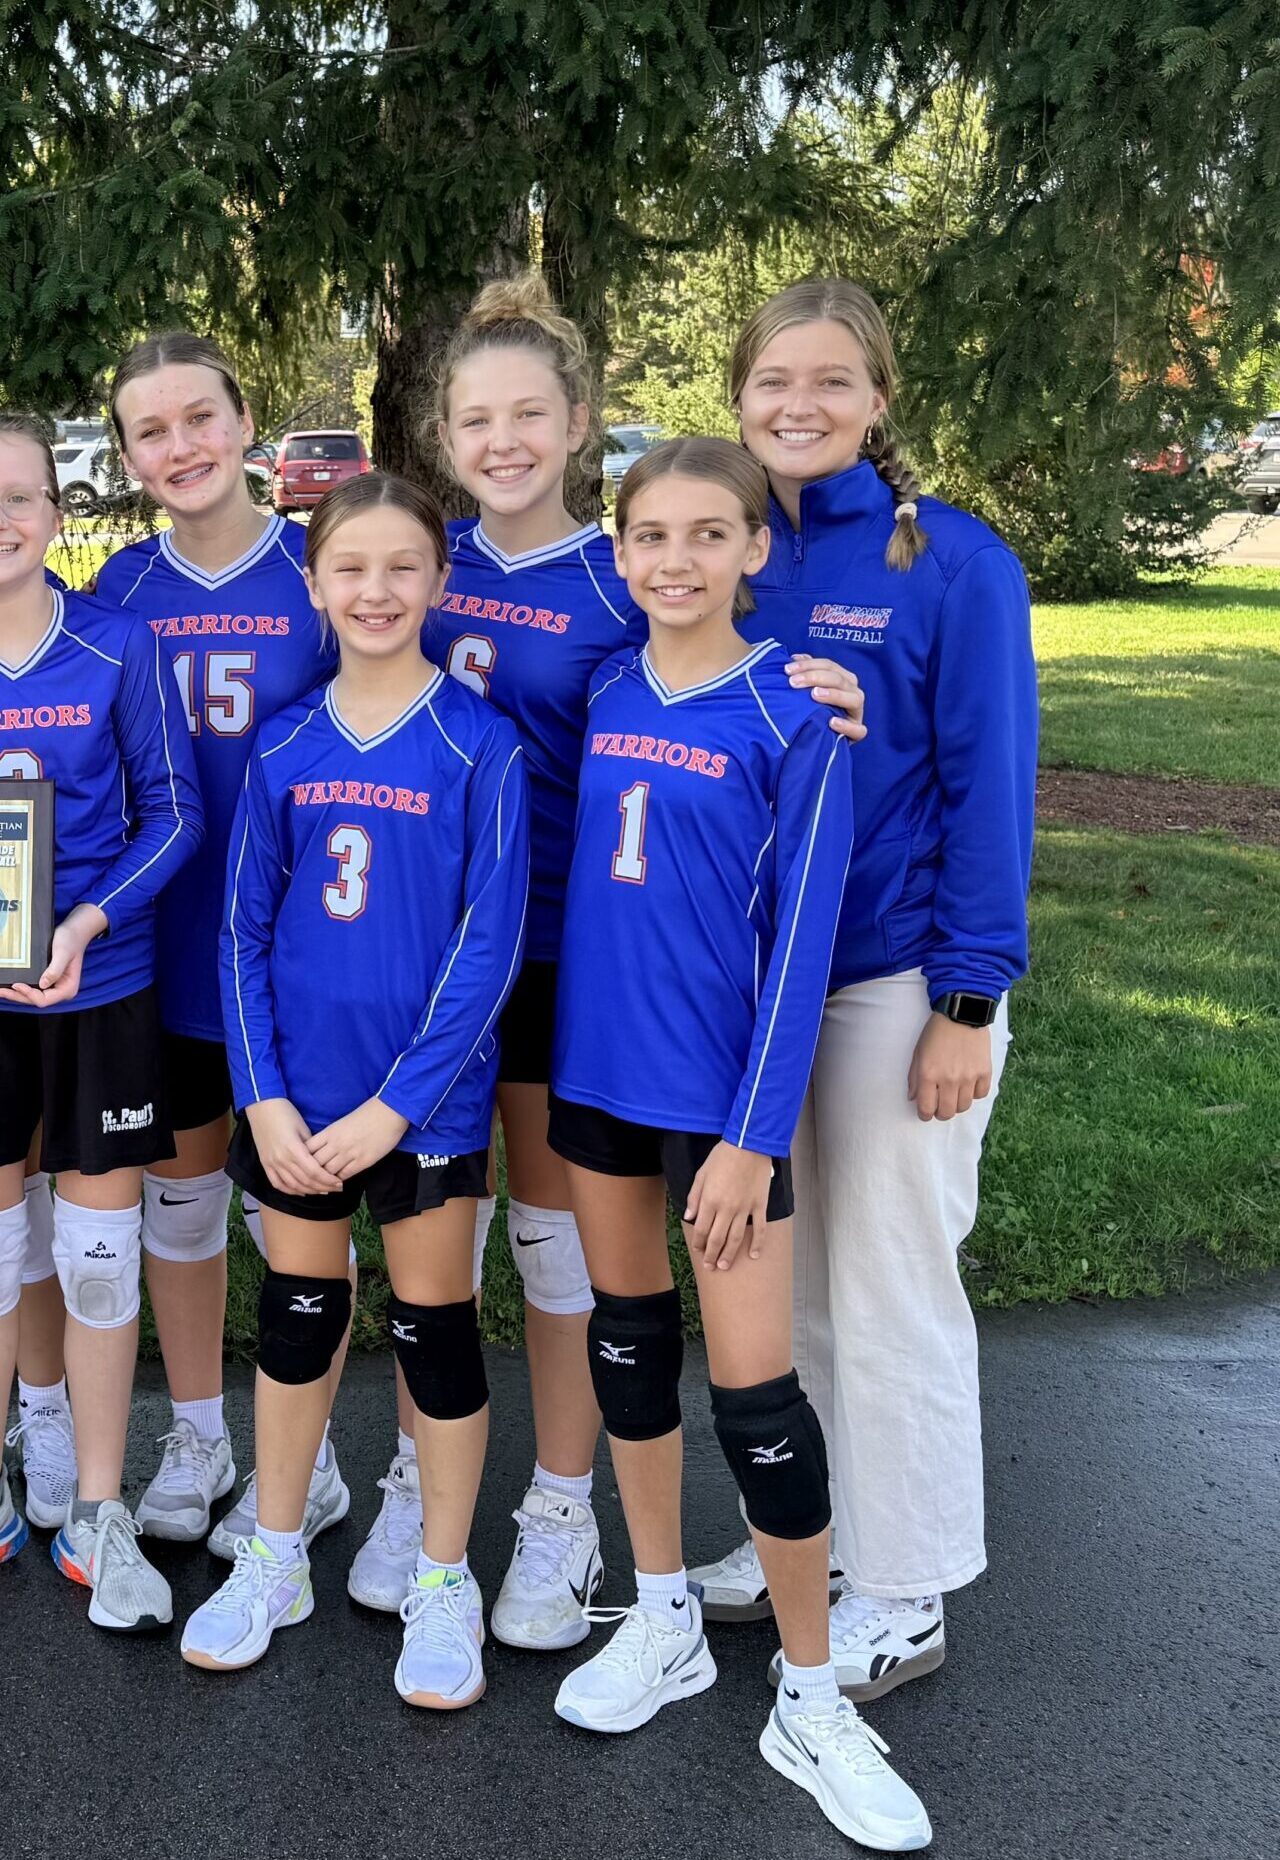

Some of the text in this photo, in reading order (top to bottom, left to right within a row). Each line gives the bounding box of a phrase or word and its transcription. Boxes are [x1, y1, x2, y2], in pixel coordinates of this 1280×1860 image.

[808, 626, 885, 644] VOLLEYBALL
[173, 651, 256, 737] 15
[446, 632, 497, 700] 6
[590, 733, 729, 779] WARRIORS
[289, 781, 430, 816] WARRIORS
[611, 781, 650, 885] 1
[323, 823, 372, 922] 3
[84, 1249, 117, 1260] MIKASA
